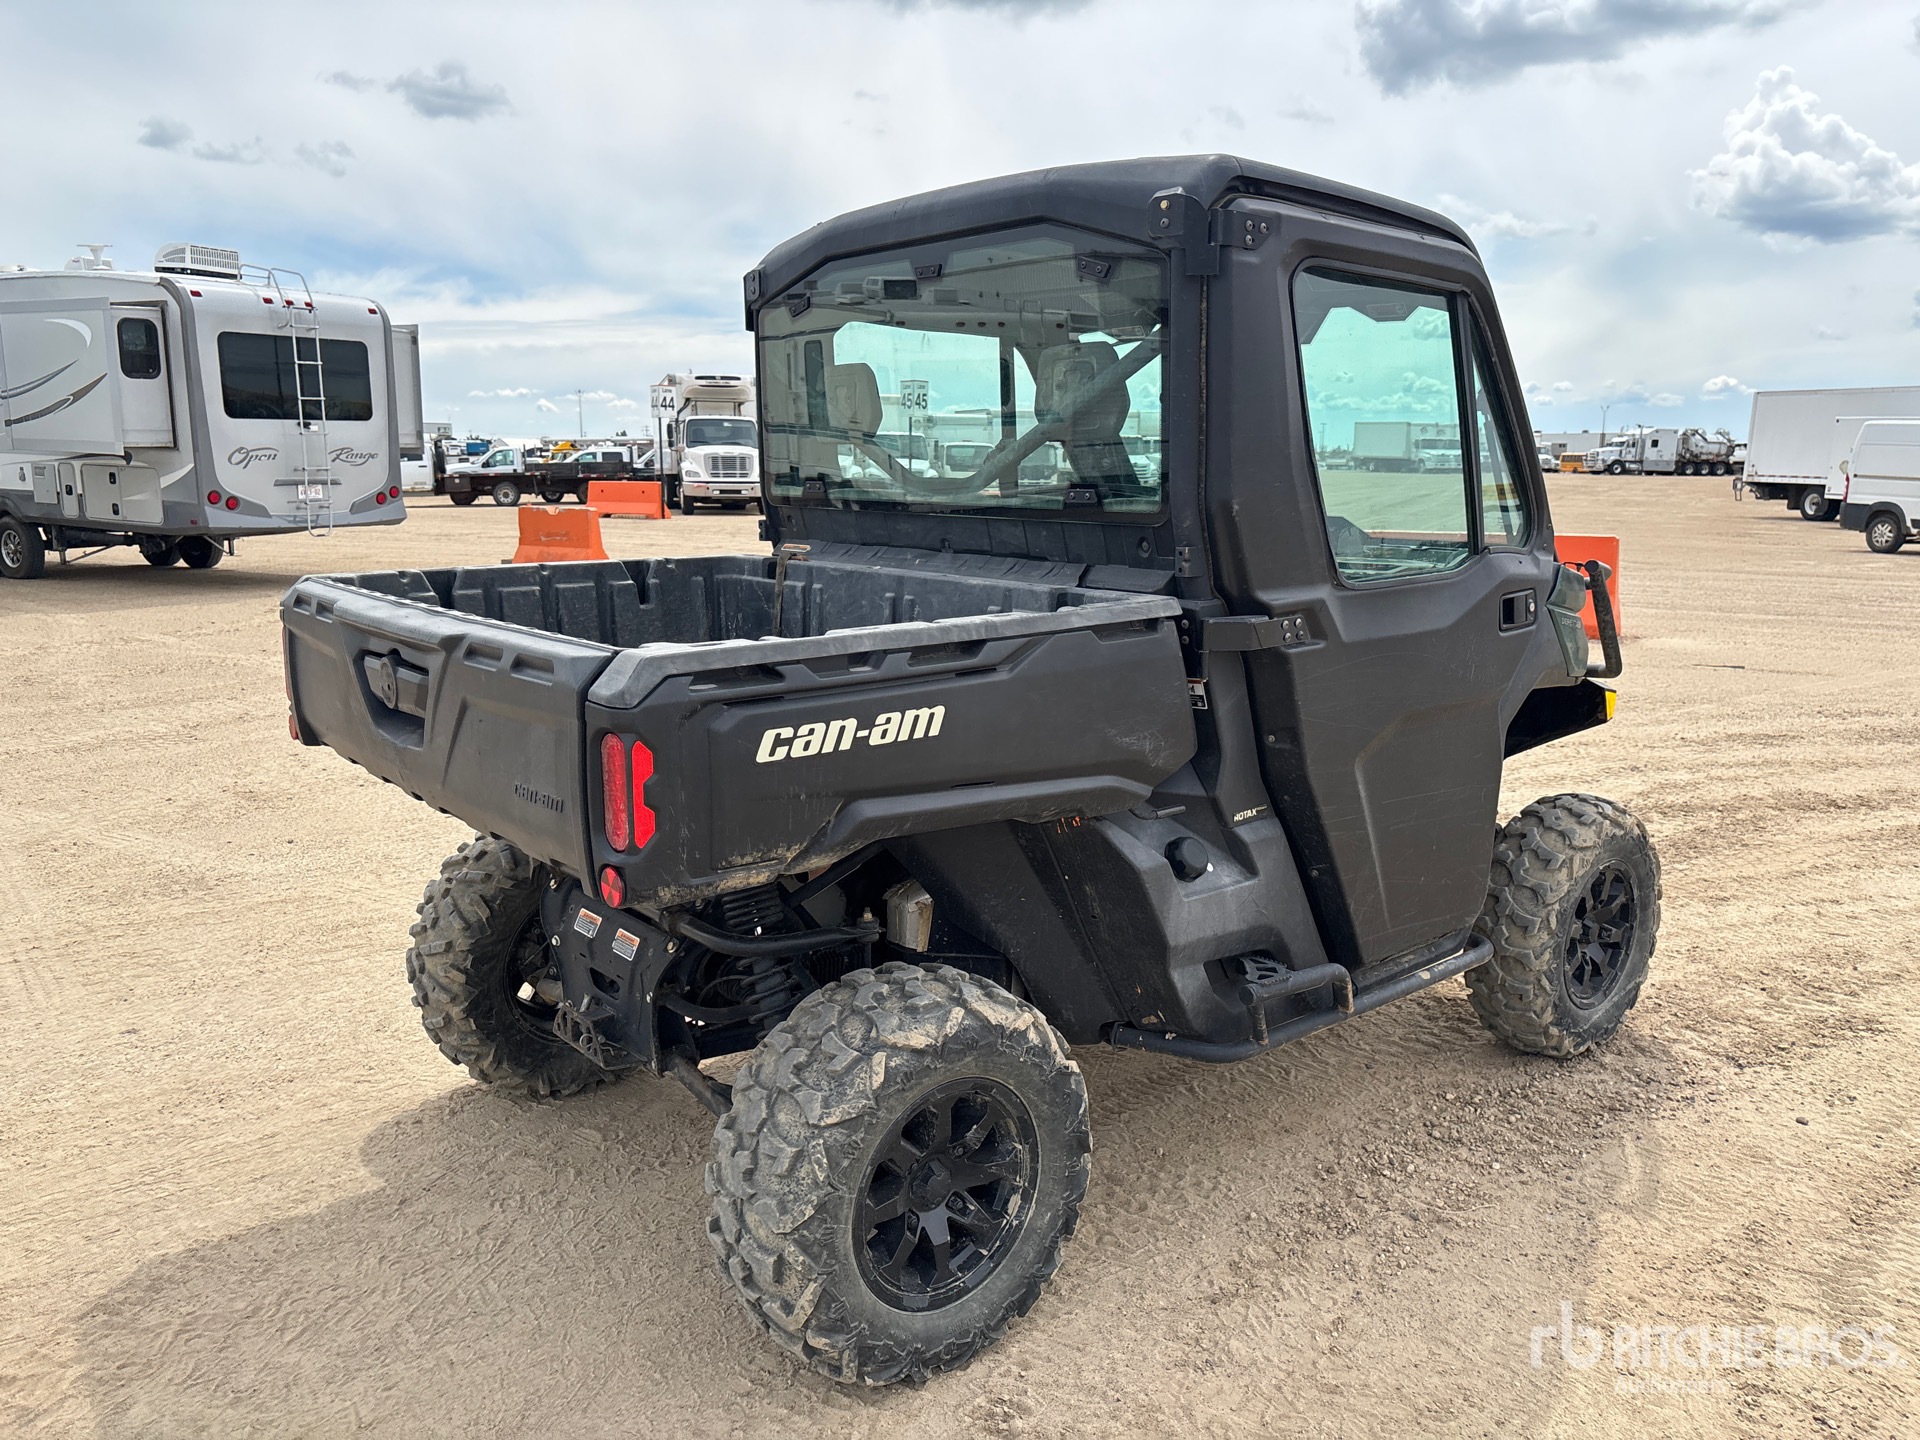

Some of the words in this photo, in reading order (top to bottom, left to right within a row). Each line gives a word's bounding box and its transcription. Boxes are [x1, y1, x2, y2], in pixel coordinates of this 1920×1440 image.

[660, 396, 675, 411] 44
[901, 393, 912, 409] 45
[915, 393, 927, 409] 45
[227, 446, 280, 470] Open
[327, 446, 380, 467] Range
[755, 705, 946, 764] can-am
[1233, 807, 1257, 822] ROTAX
